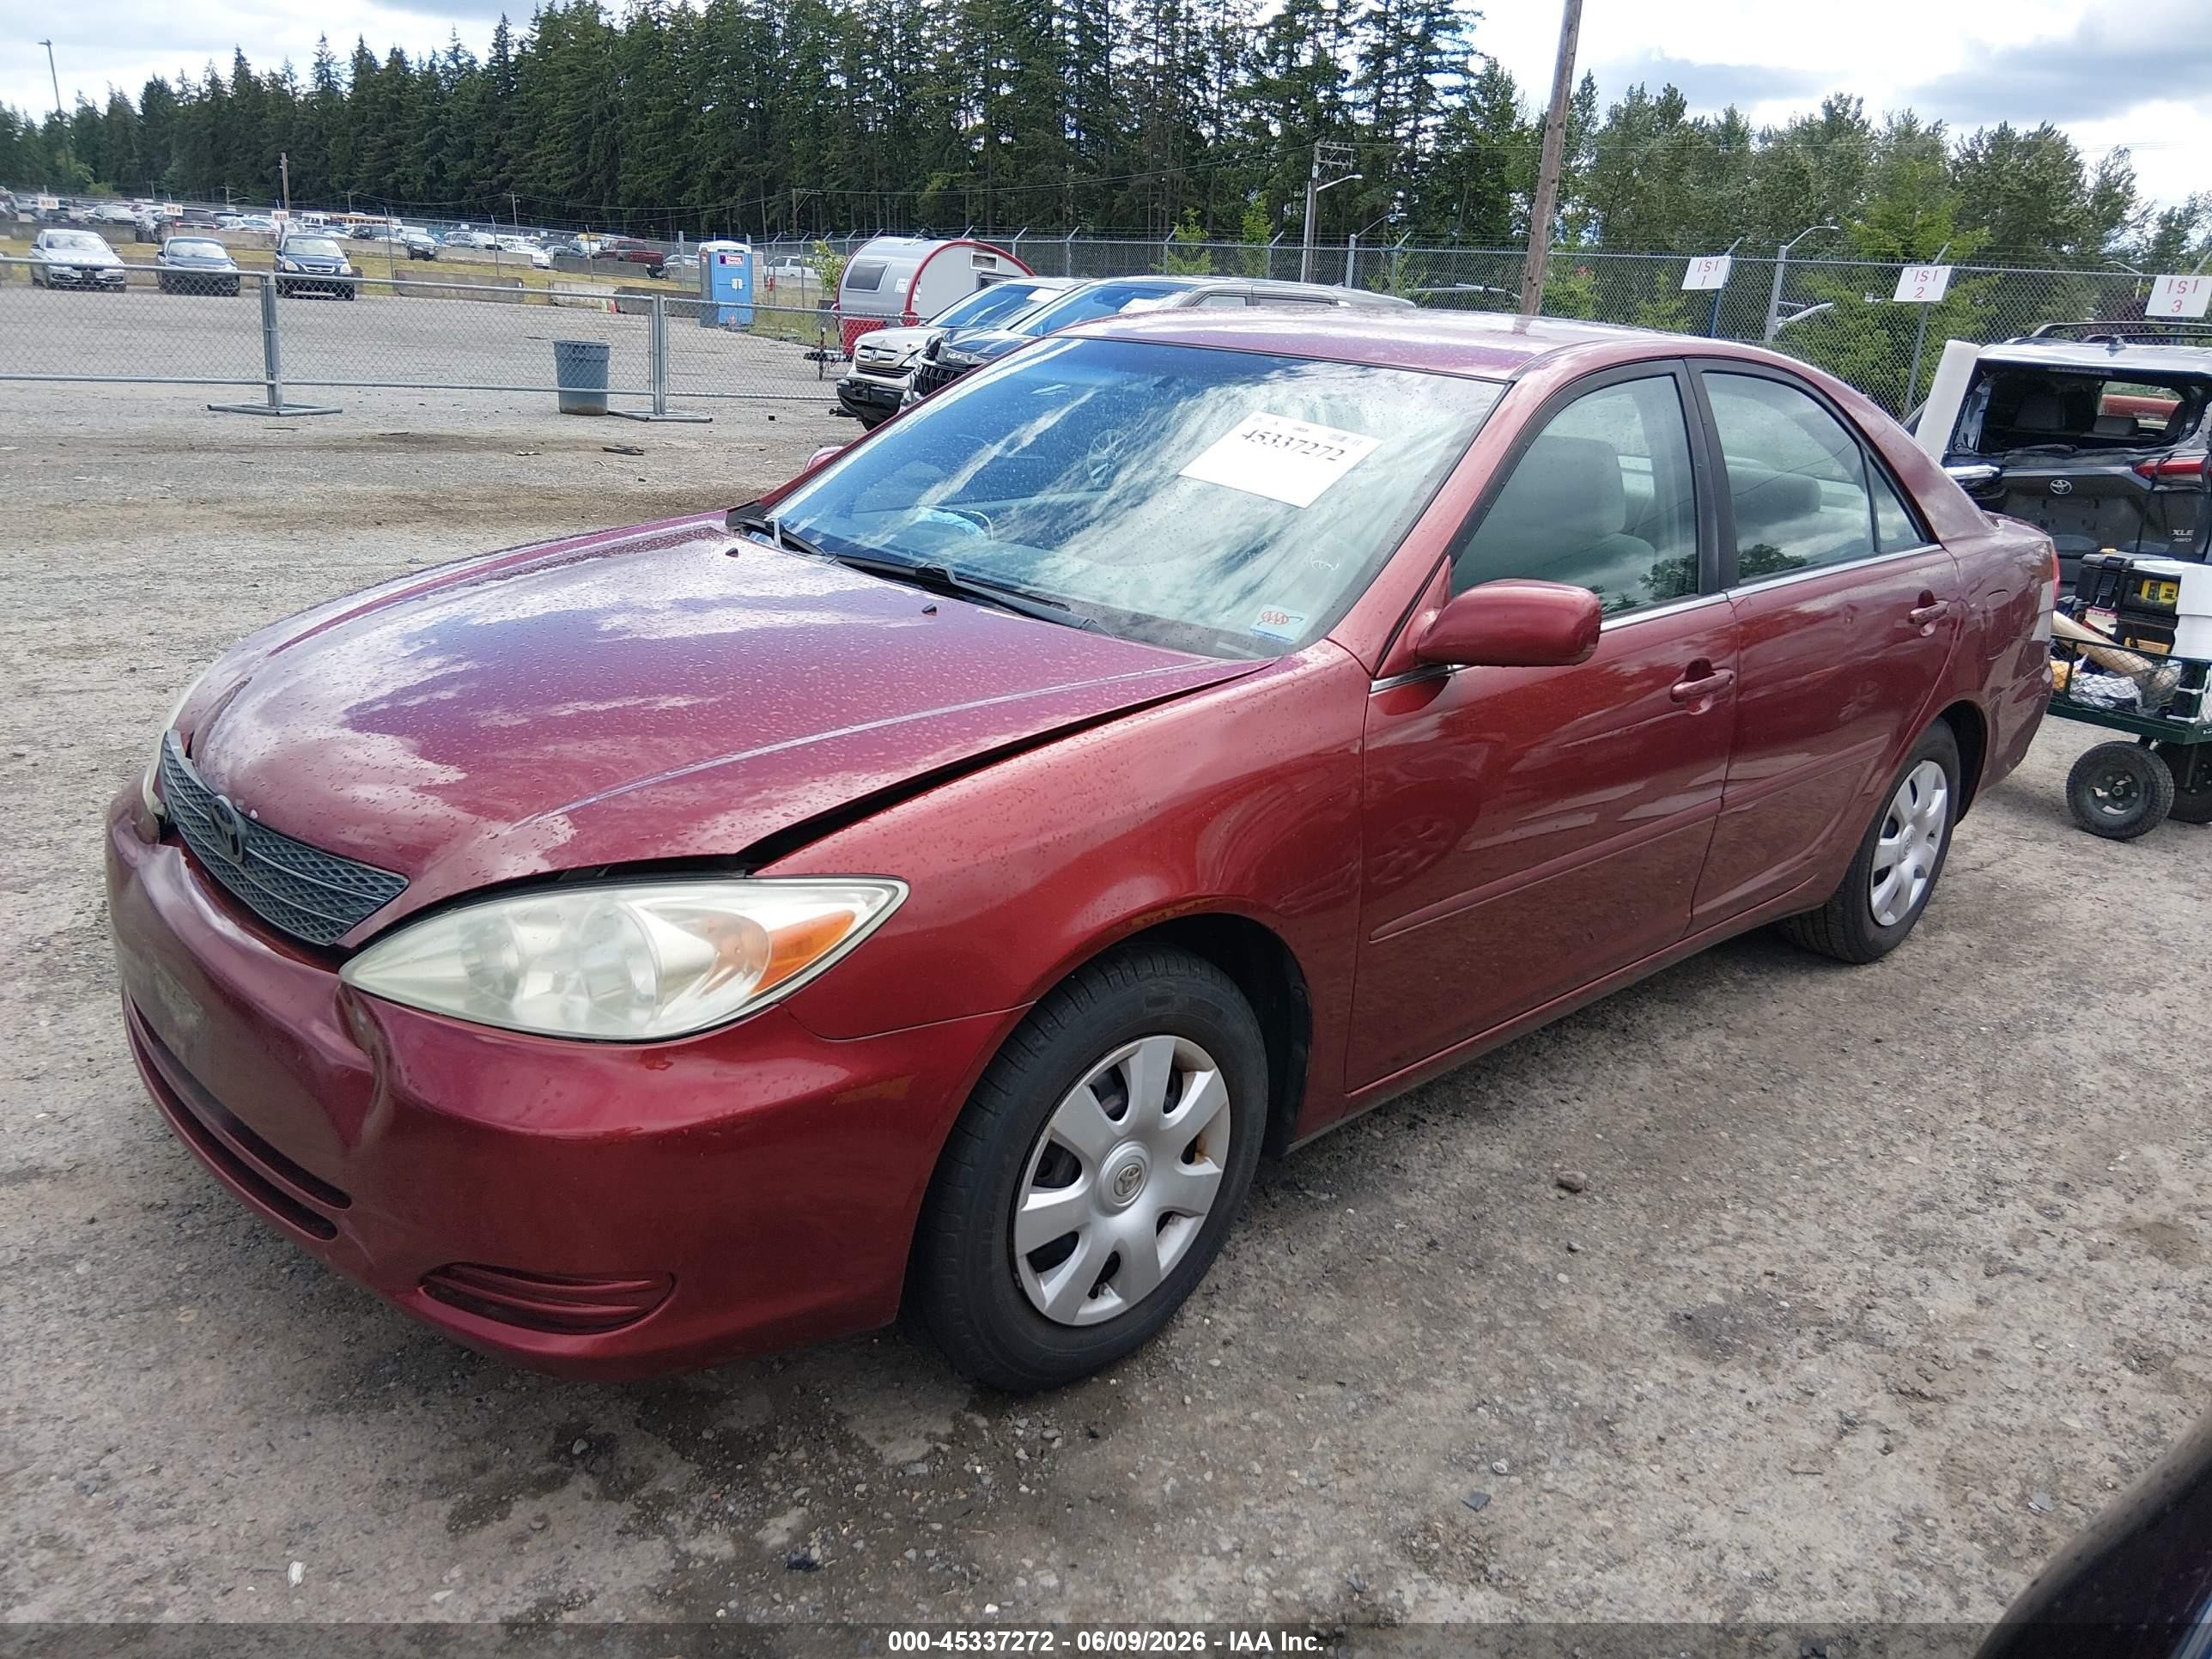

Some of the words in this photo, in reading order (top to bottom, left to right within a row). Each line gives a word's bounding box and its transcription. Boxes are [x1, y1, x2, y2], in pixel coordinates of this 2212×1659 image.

[1913, 286, 1925, 299] 2
[2171, 299, 2183, 313] 3
[1241, 428, 1346, 462] 45337272
